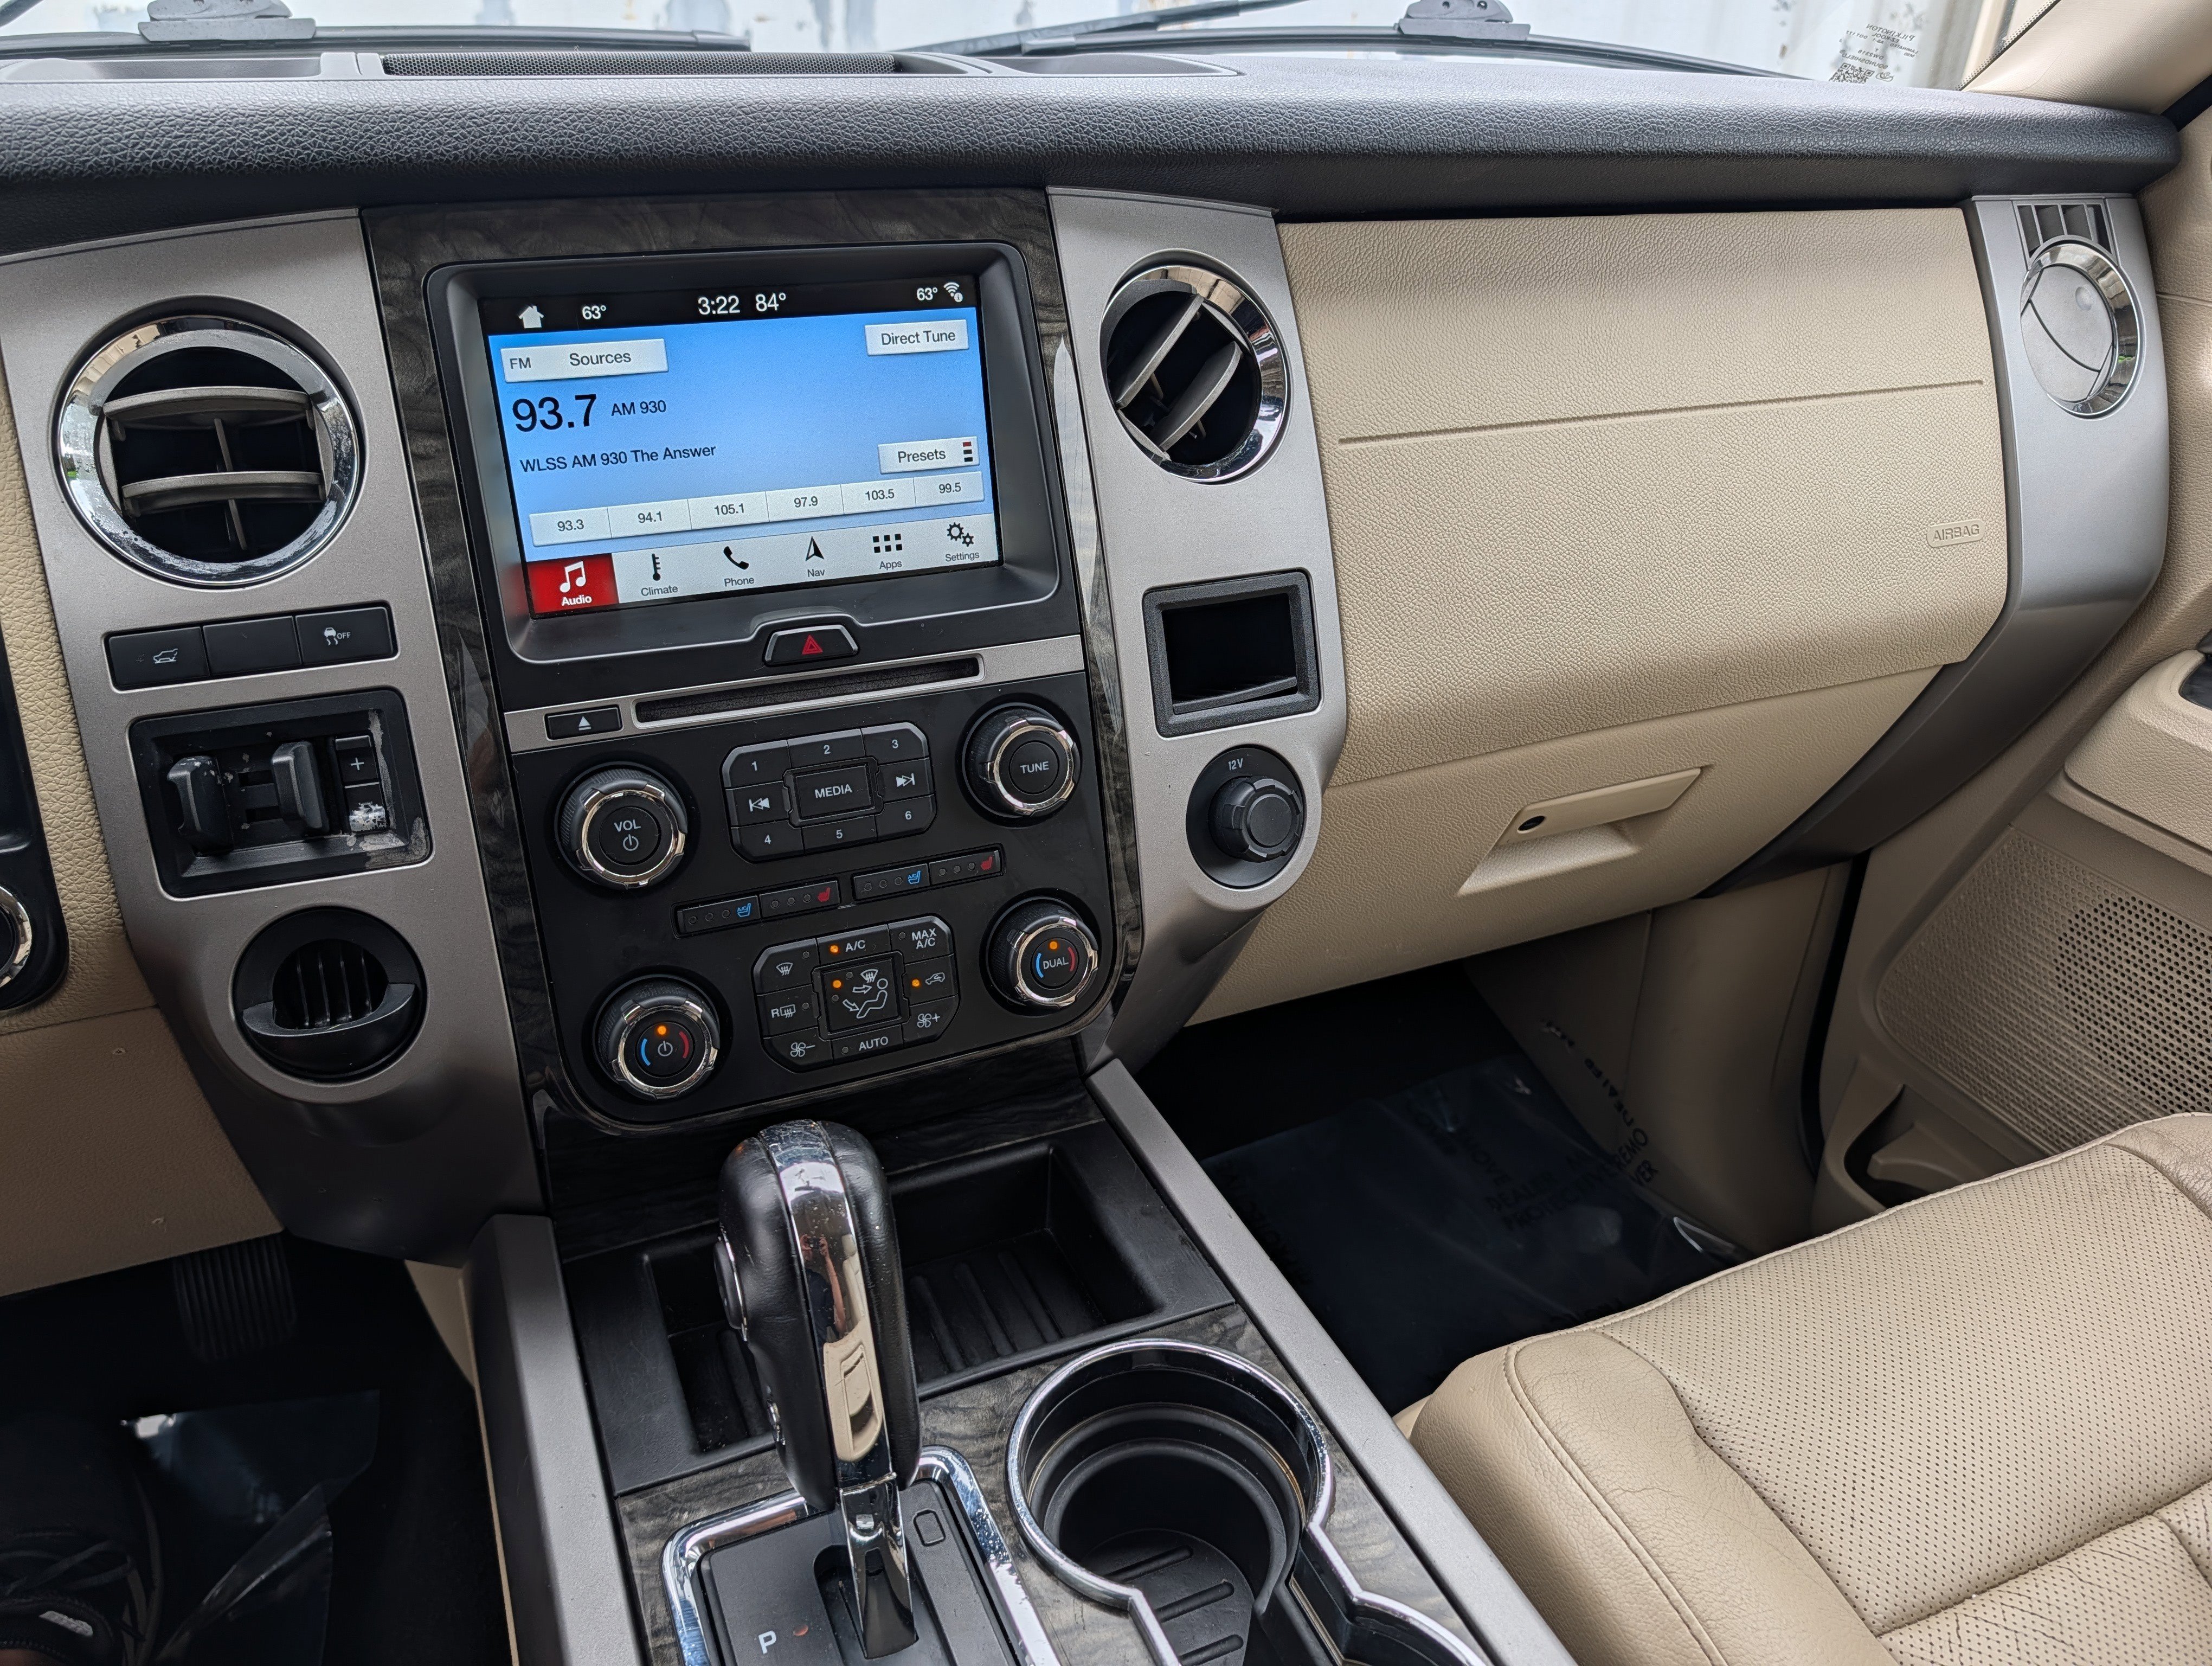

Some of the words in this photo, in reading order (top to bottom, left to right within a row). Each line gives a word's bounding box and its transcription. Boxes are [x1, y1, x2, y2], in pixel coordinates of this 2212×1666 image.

[698, 296, 740, 315] 3:22
[882, 332, 920, 345] Direct
[923, 330, 955, 342] Tune
[510, 357, 531, 369] FM
[570, 353, 631, 366] Sources
[512, 394, 596, 432] 93.7
[612, 402, 635, 416] AM
[640, 400, 666, 414] 930
[519, 457, 567, 472] WLSS
[572, 454, 596, 468] AM
[601, 451, 627, 465] 930
[631, 450, 658, 462] The
[663, 446, 716, 460] Answer
[898, 449, 946, 463] Presets
[939, 482, 961, 494] 99.5
[865, 489, 894, 501] 103.5
[794, 496, 818, 508] 97.9
[715, 503, 744, 515] 105.1
[638, 511, 662, 523] 94.1
[557, 519, 584, 531] 93.3
[1932, 524, 1980, 541] AIRBAG
[946, 552, 980, 564] Settings
[879, 561, 902, 572] Apps
[808, 569, 825, 577] Nav
[724, 576, 754, 588] Phone
[641, 584, 678, 596] Climate
[562, 593, 592, 606] Audio
[337, 631, 351, 640] OFF
[824, 745, 831, 754] 2
[892, 740, 898, 748] 3
[752, 761, 757, 771] 1
[1020, 761, 1049, 773] TUNE
[1229, 758, 1243, 770] 12V
[815, 784, 852, 798] MEDIA
[905, 811, 911, 819] 6
[614, 819, 641, 831] VOL
[764, 835, 771, 844] 4
[837, 829, 843, 838] 5
[912, 928, 936, 941] MAX
[846, 940, 865, 952] A/C
[915, 937, 935, 949] A/C
[1043, 957, 1069, 969] DUAL
[771, 1009, 780, 1018] R
[859, 1036, 888, 1050] AUTO
[1613, 1127, 1650, 1171] REMO
[1630, 1159, 1660, 1188] VER
[758, 1631, 776, 1654] P
